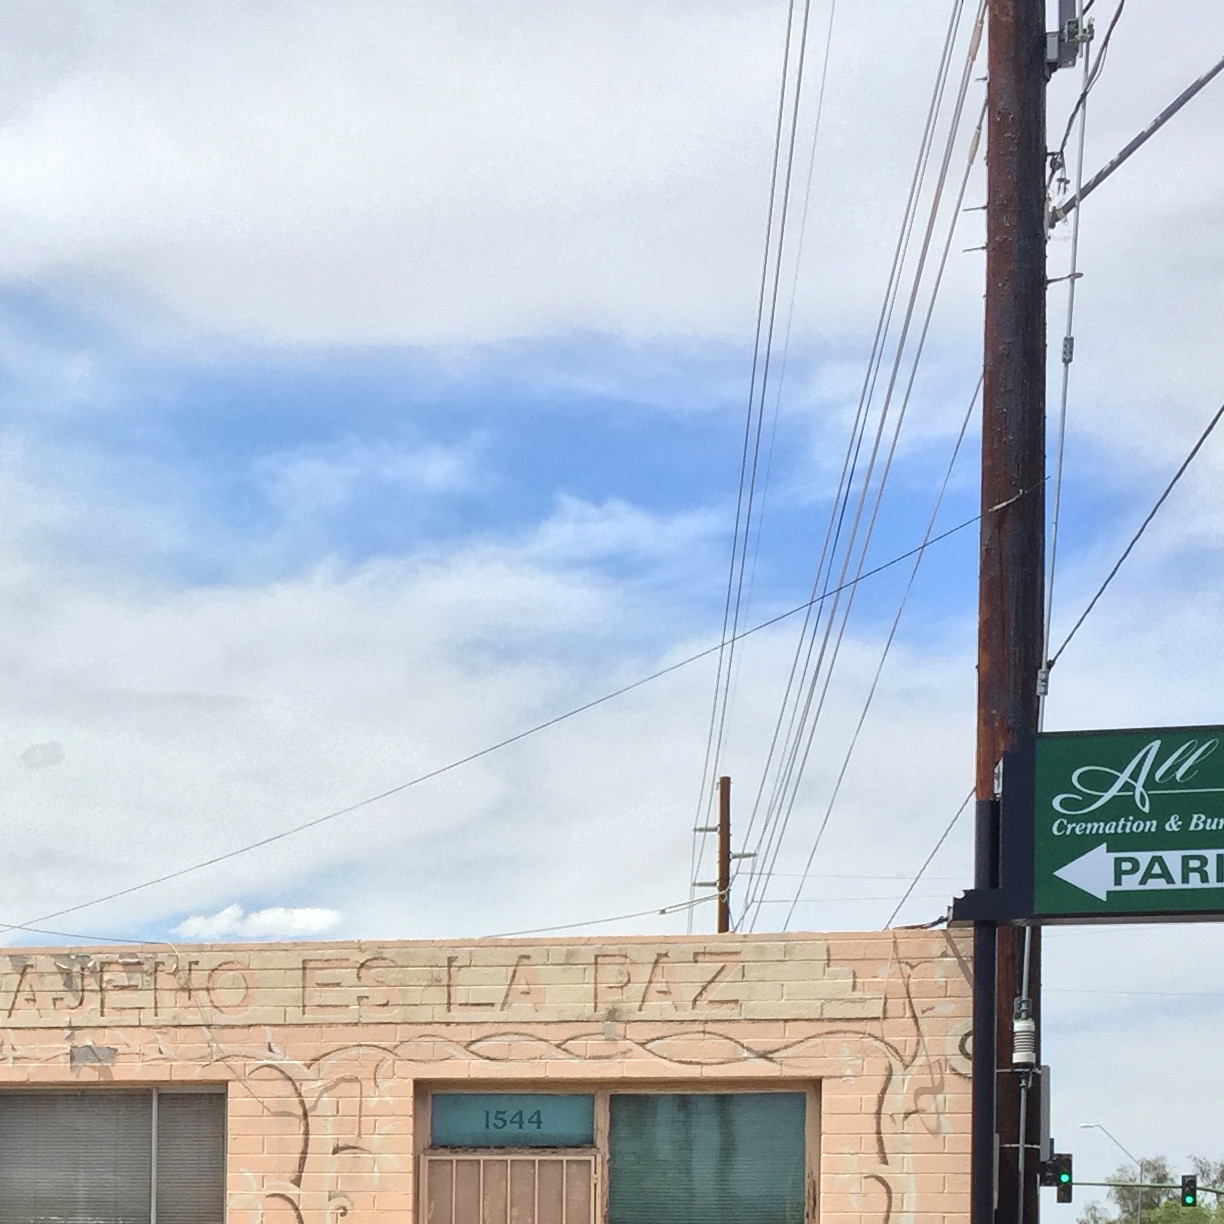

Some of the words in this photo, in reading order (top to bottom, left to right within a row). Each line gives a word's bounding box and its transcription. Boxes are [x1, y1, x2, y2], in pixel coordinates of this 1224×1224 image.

[1052, 739, 1219, 815] All
[1052, 816, 1158, 836] Cremation
[1164, 814, 1183, 832] &
[7, 960, 252, 1019] AJENO
[301, 956, 402, 1017] ES
[447, 954, 545, 1013] LA
[594, 951, 742, 1013] PAZ
[483, 1109, 543, 1130] 1544
